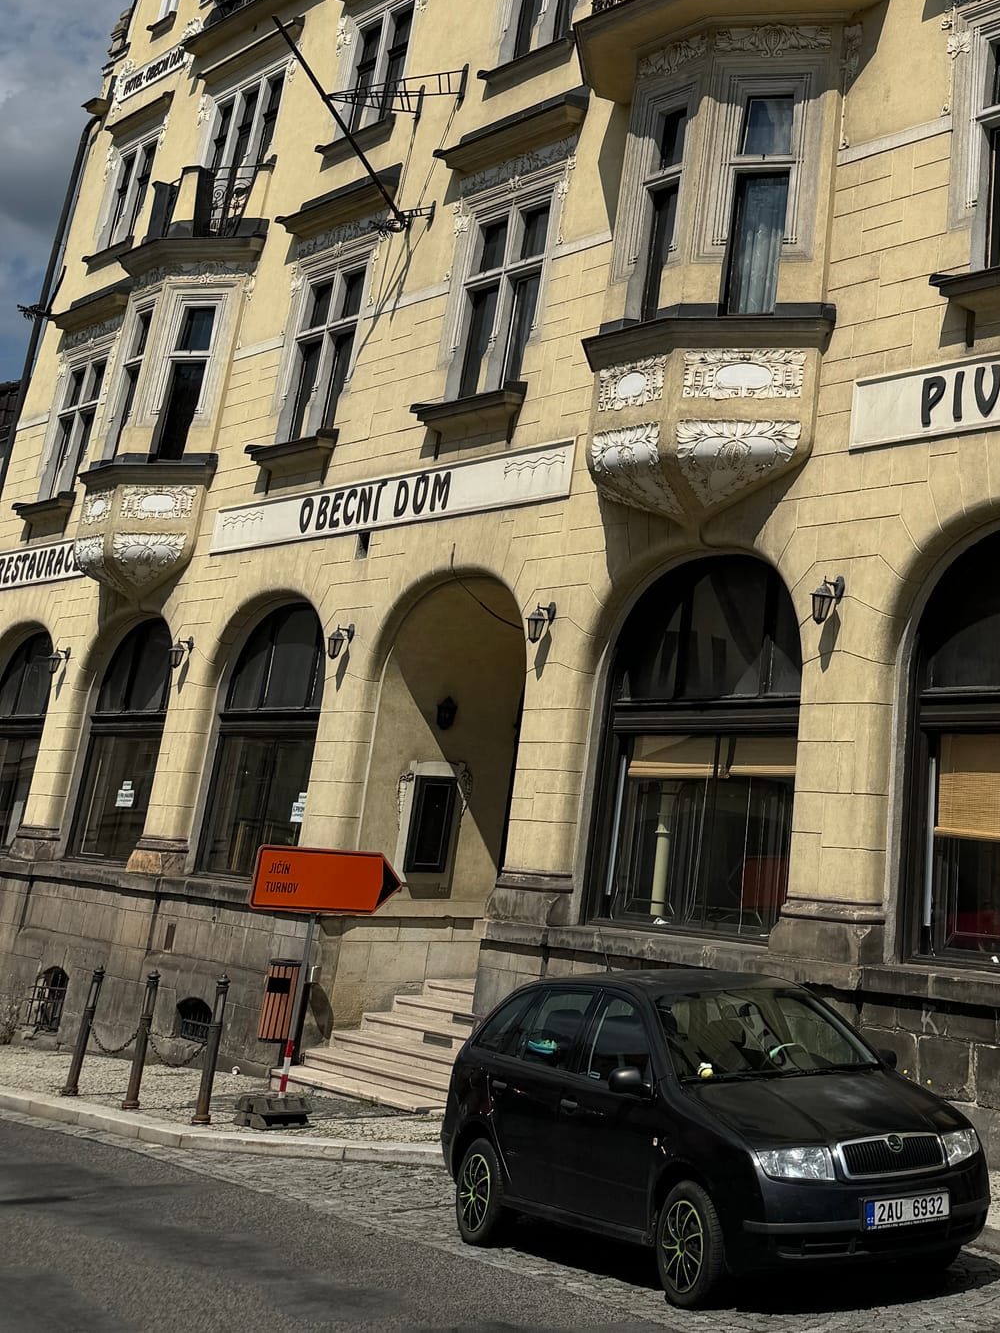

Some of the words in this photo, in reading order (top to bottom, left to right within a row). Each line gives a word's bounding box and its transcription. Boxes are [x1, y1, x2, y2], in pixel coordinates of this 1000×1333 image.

[299, 480, 390, 534] OBECNÍ
[0, 543, 82, 585] RESTAURAC
[268, 860, 291, 875] JIČÍN
[265, 881, 298, 894] TURNOV
[878, 1201, 904, 1223] 2AU
[912, 1196, 944, 1218] 6932
